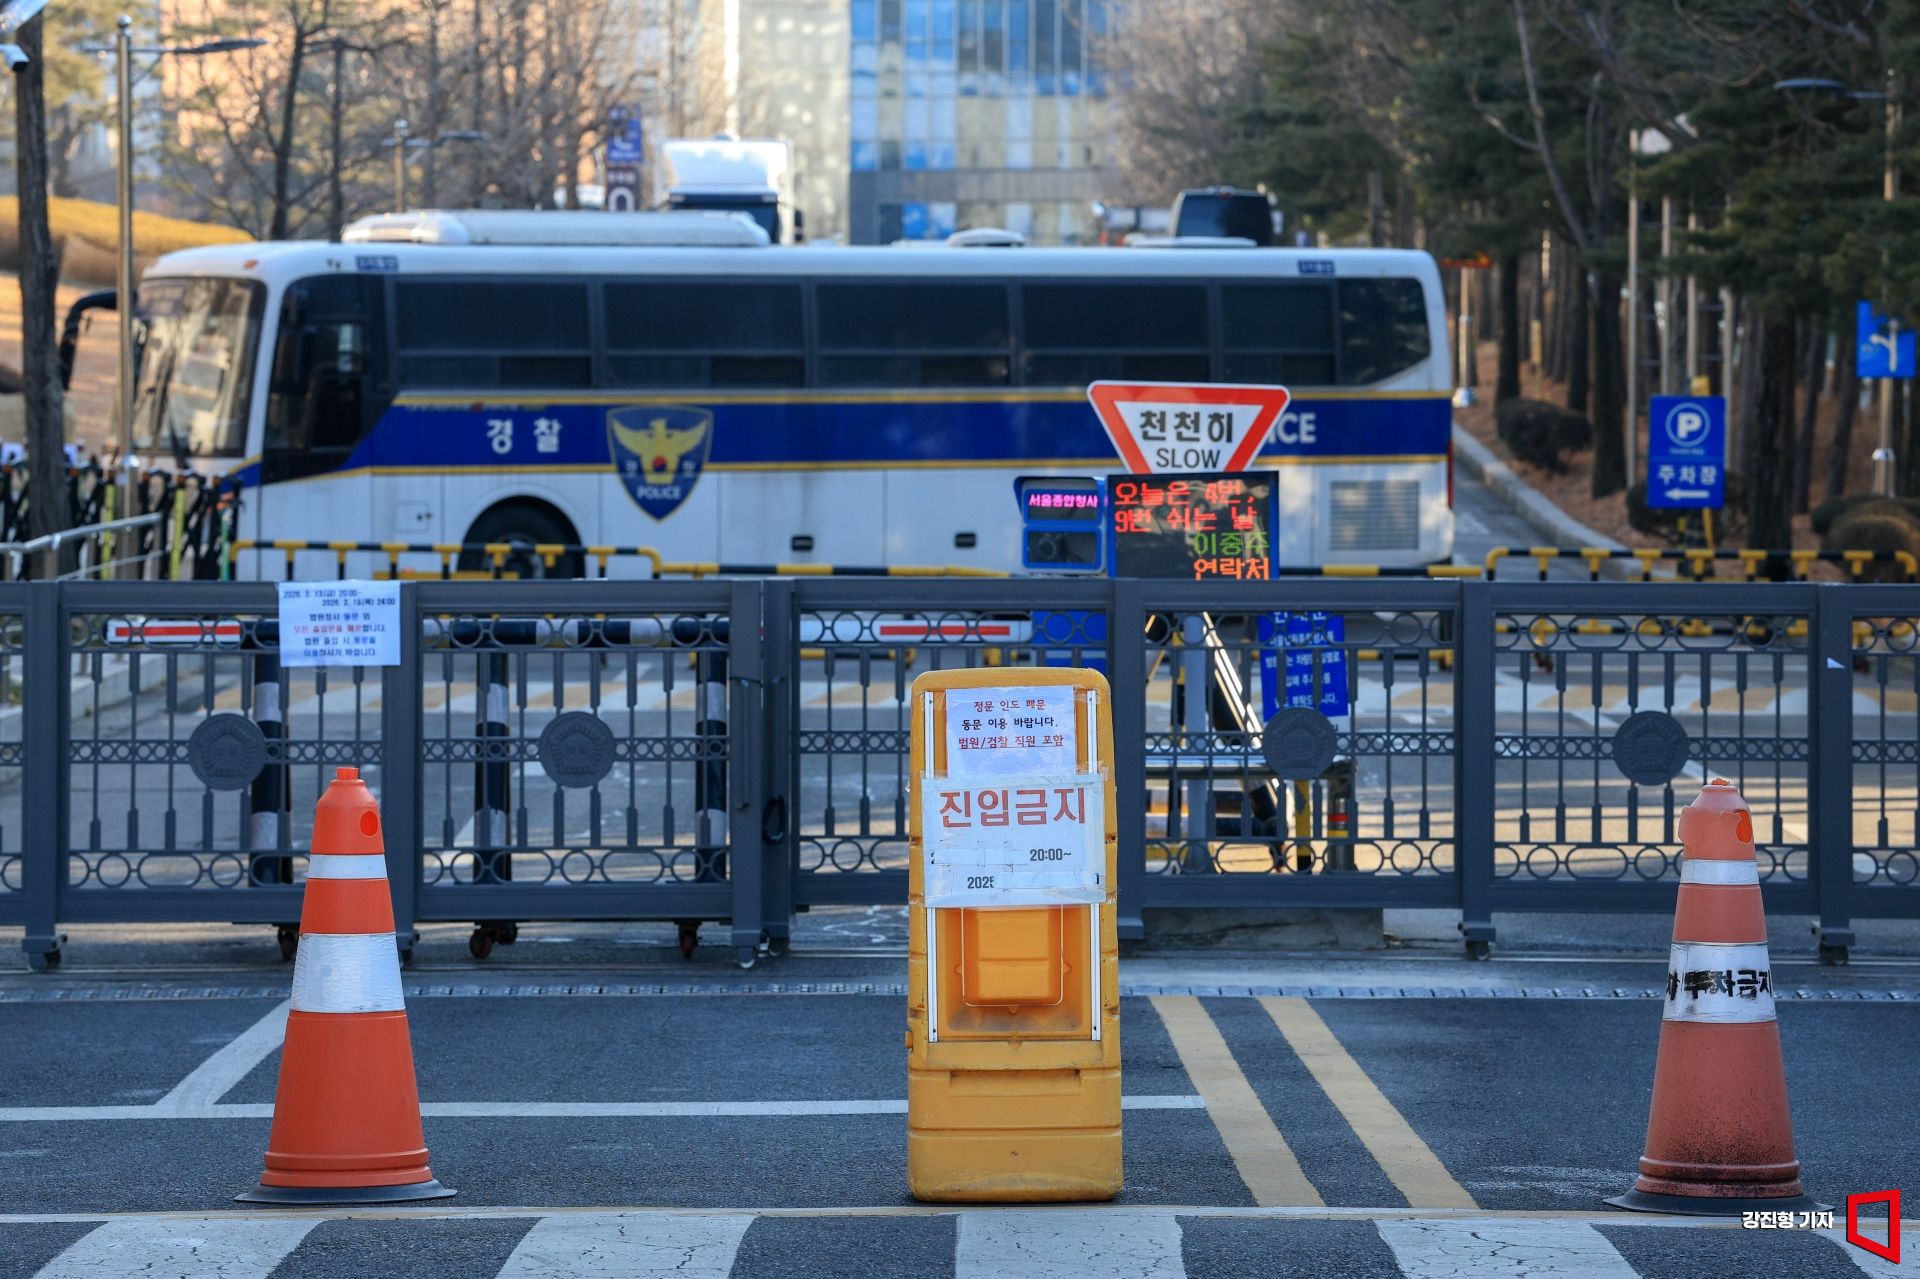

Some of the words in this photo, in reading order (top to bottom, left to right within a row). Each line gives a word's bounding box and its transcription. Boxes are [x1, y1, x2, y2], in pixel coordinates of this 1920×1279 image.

[1139, 410, 1233, 443] 천천히
[1676, 412, 1702, 438] P
[1156, 448, 1220, 469] SLOW
[1658, 465, 1717, 486] 주차장
[636, 485, 681, 500] POLICE
[1115, 481, 1190, 506] 오늘은
[1203, 480, 1255, 504] 4번,
[1114, 509, 1152, 532] 9번
[1167, 507, 1217, 531] 쉬는
[1231, 506, 1257, 530] 날
[1193, 531, 1269, 556] 이중주
[1193, 557, 1269, 581] 연락처
[973, 700, 994, 712] 정문
[1000, 700, 1020, 712] 인도
[1025, 699, 1046, 711] 폐문
[961, 719, 983, 731] 동문
[988, 718, 1008, 730] 이용
[1013, 716, 1058, 729] 바랍니다.
[958, 736, 1008, 750] 법원/검찰
[1015, 736, 1036, 748] 직원
[1042, 735, 1064, 748] 포함
[939, 787, 1086, 828] 진입금지
[1029, 848, 1072, 861] 20:00~
